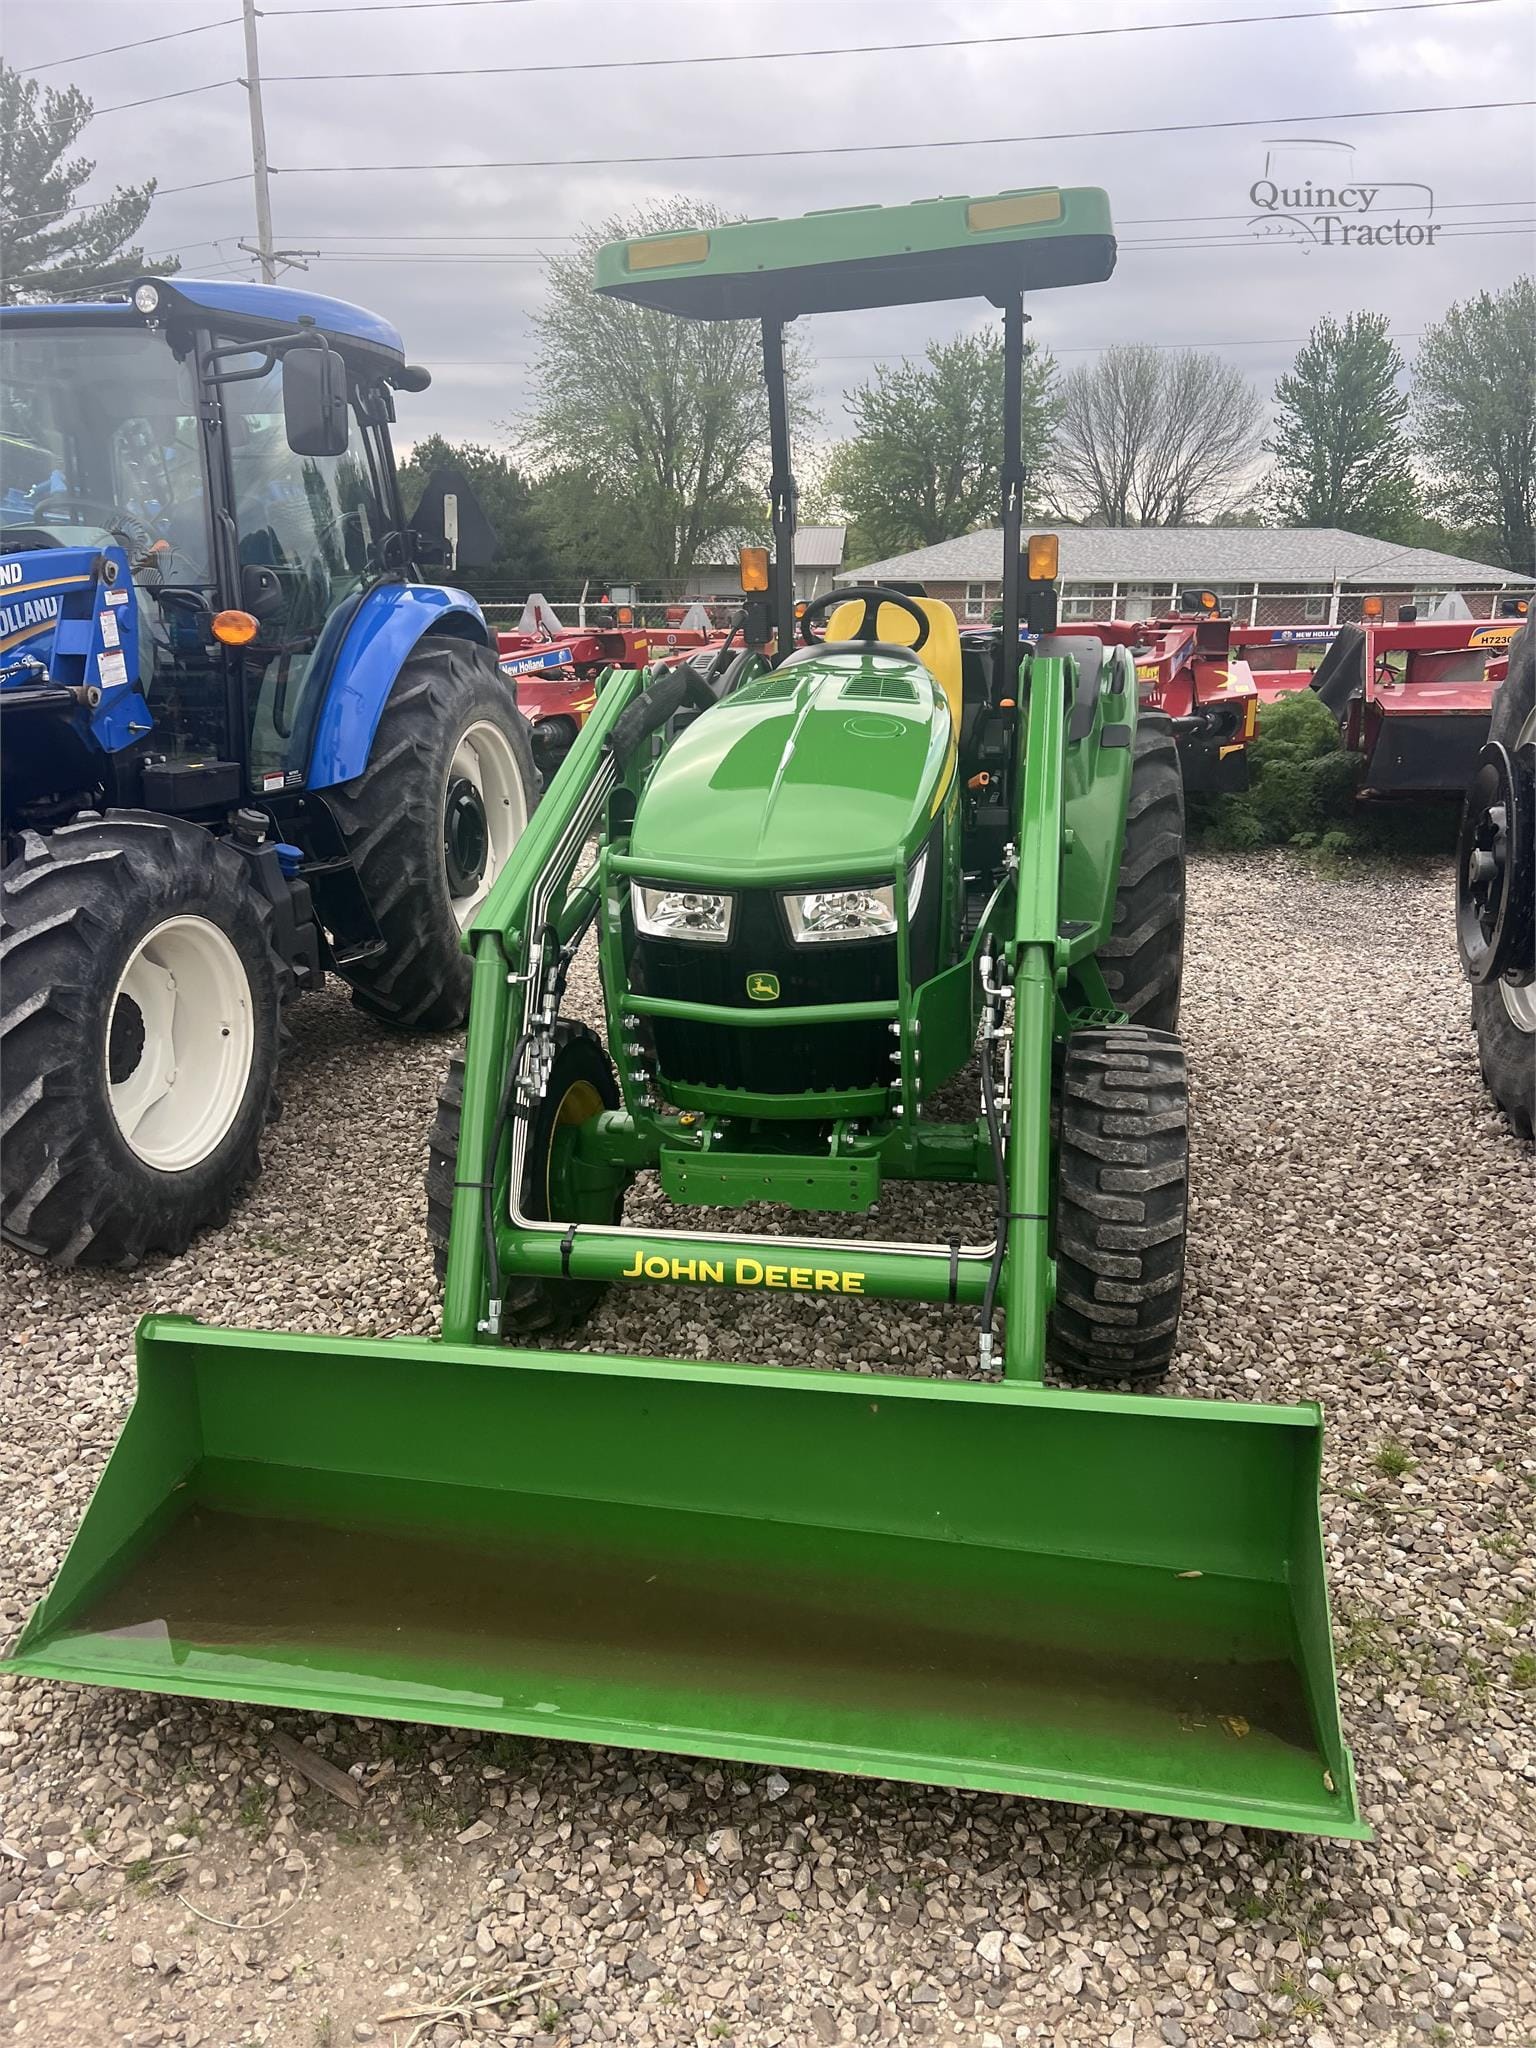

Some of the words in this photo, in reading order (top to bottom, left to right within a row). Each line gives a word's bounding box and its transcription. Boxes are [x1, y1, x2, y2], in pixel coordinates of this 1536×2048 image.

[0, 596, 58, 637] OLLAND
[501, 664, 518, 674] New
[519, 657, 545, 673] Holland
[623, 1250, 724, 1283] JOHN
[735, 1258, 865, 1294] DEERE
